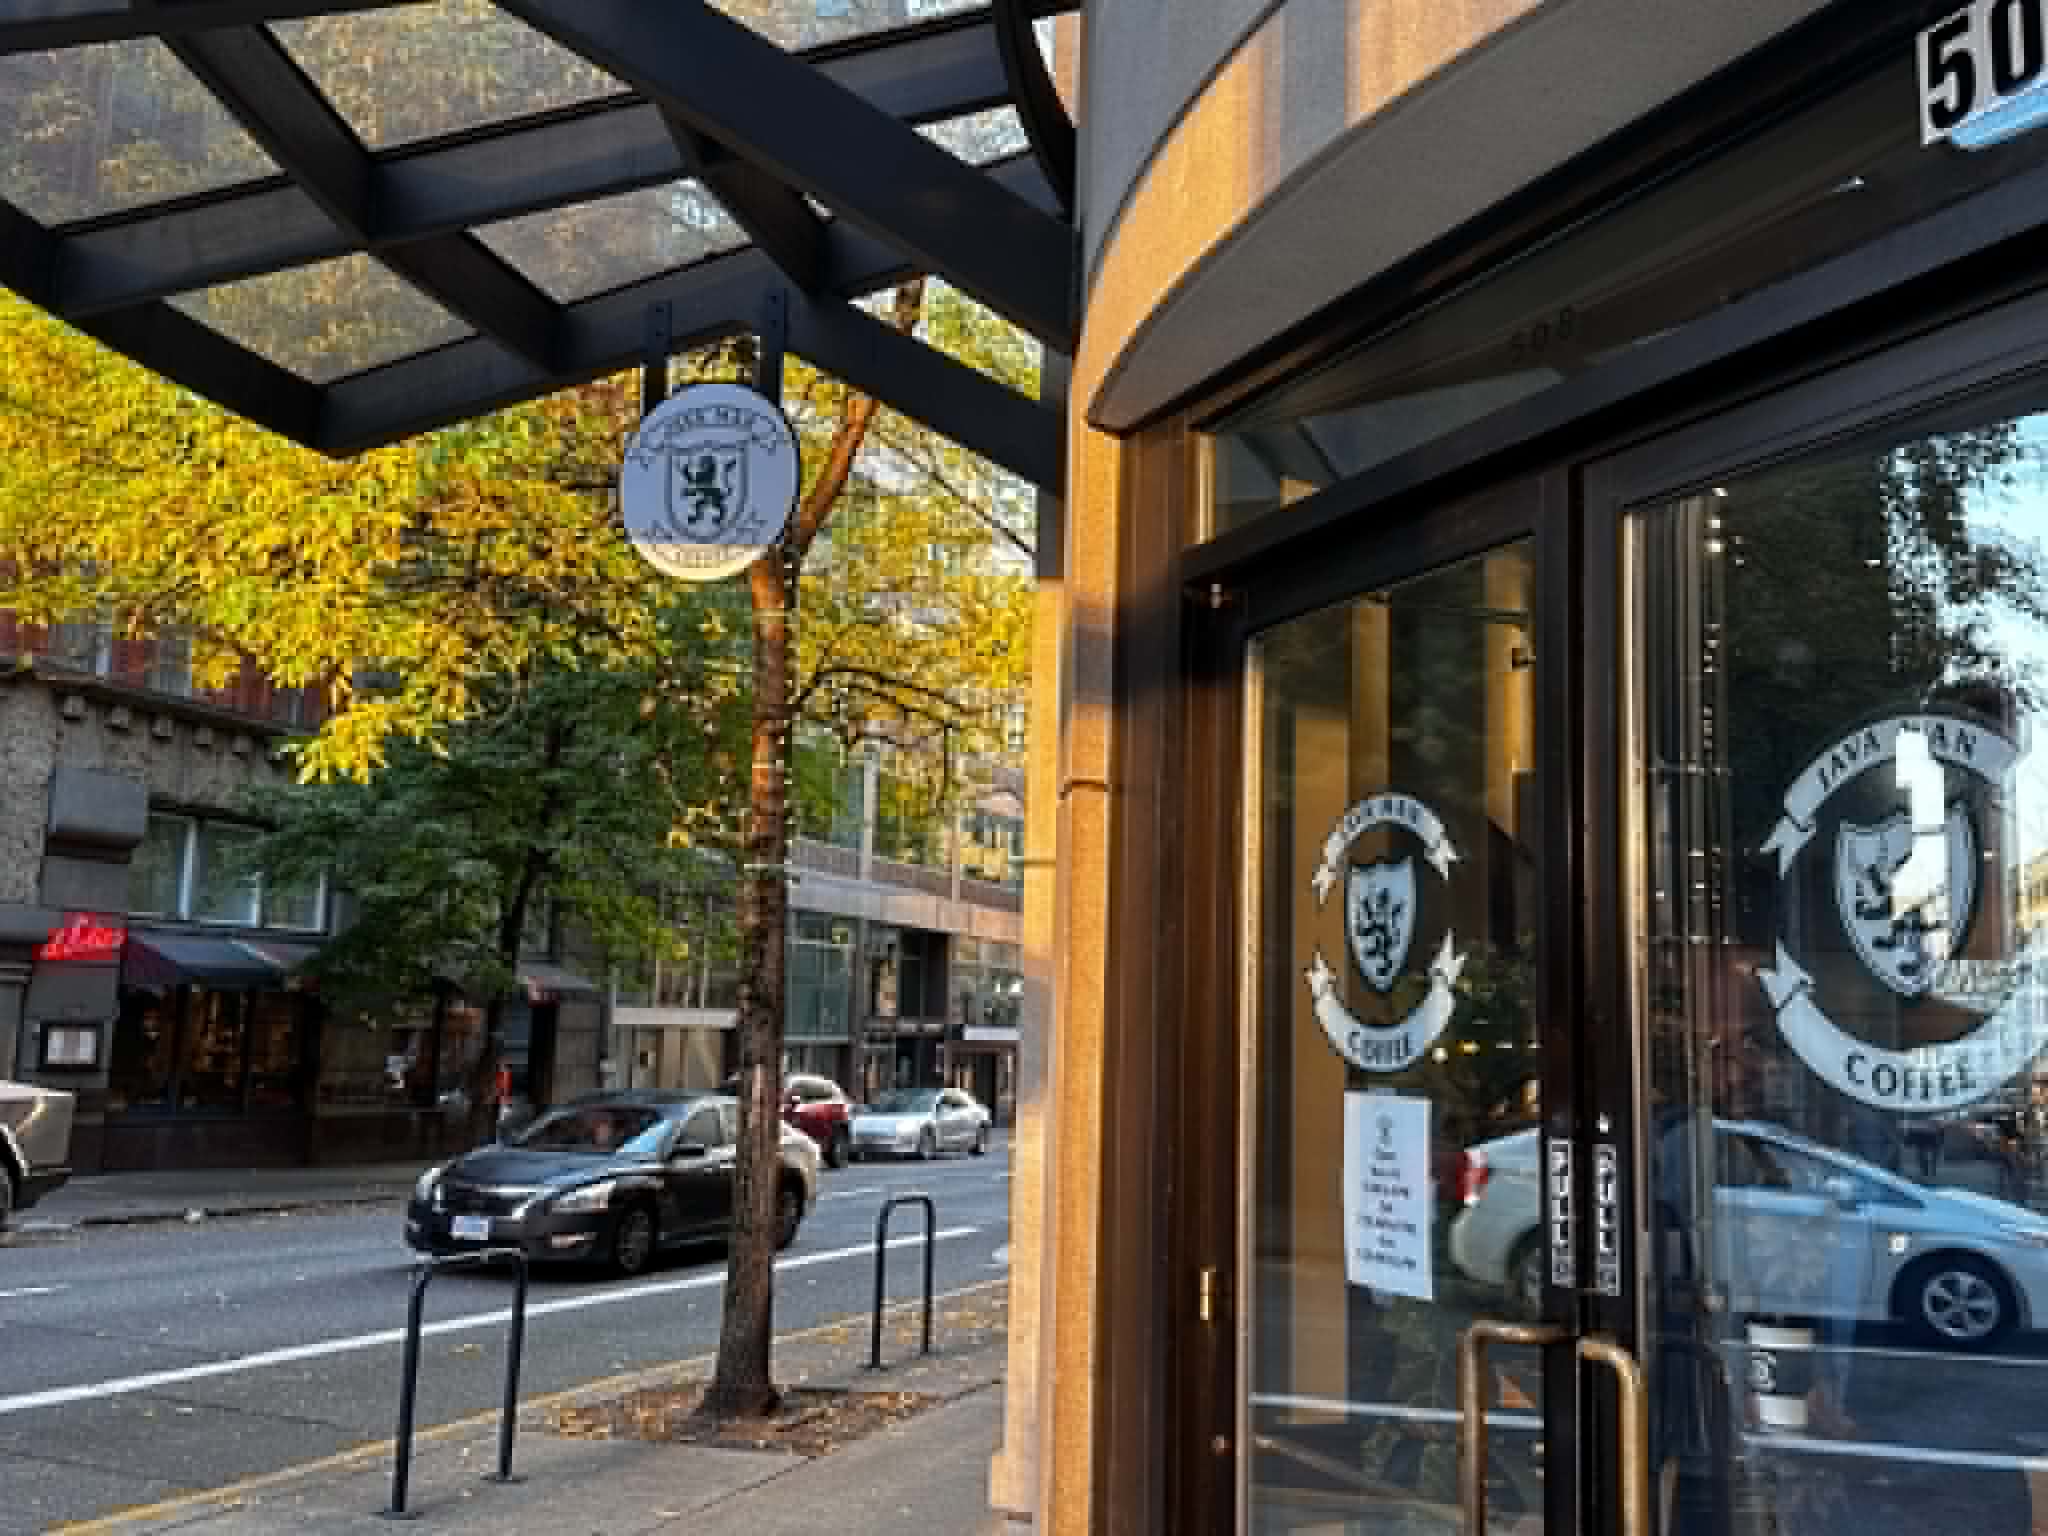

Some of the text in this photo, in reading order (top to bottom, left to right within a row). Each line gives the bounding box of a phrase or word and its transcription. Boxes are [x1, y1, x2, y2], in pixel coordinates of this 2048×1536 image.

[1927, 0, 2044, 130] 50
[1816, 721, 1978, 791] JAVA AN
[1845, 1052, 1978, 1101] COFFEE
[1550, 1149, 1570, 1248] PULL
[1598, 1151, 1617, 1254] PULL
